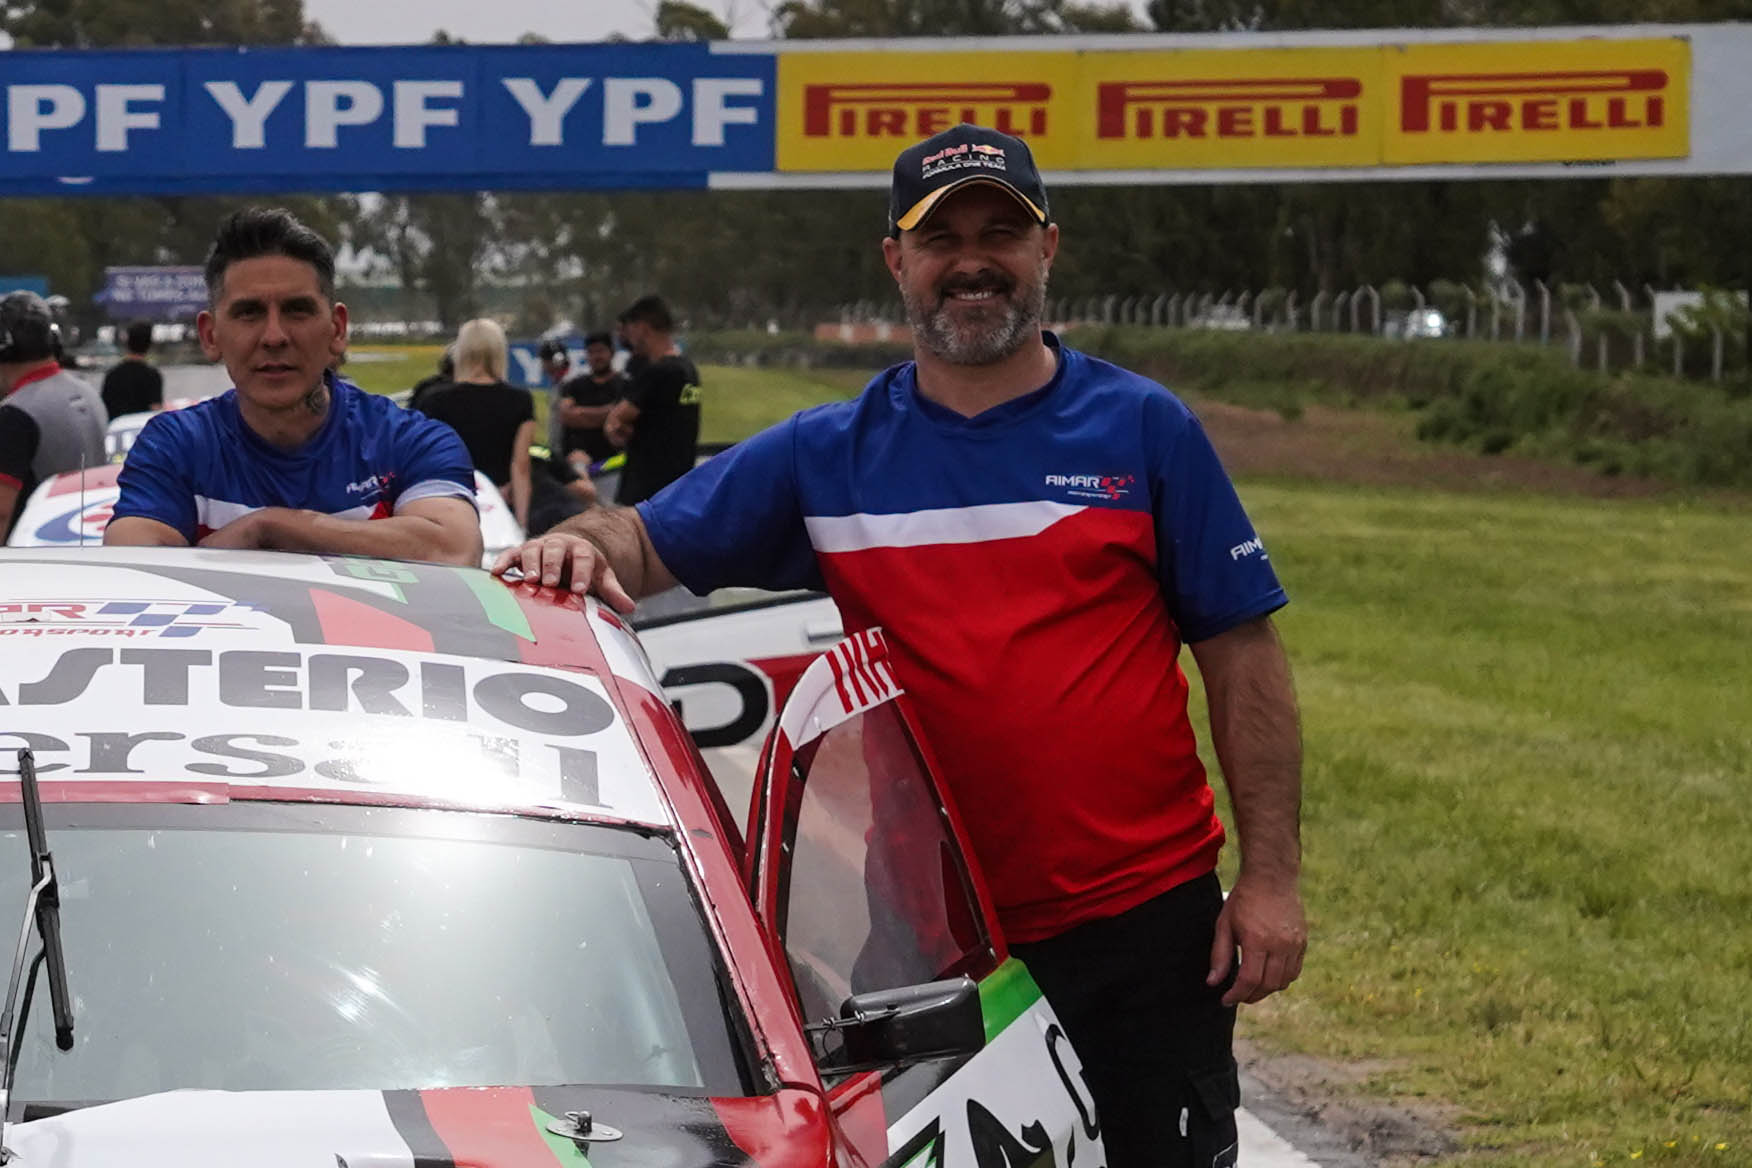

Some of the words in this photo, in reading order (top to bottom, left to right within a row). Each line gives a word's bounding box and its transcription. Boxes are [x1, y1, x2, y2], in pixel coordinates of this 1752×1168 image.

[204, 80, 465, 148] YPF
[502, 77, 763, 146] YPF
[803, 83, 1052, 138] PIRELLI
[1097, 78, 1362, 139] PIRELLI
[1400, 69, 1669, 133] PIRELLI
[922, 154, 1005, 172] RACING
[1045, 474, 1100, 489] AIMAR
